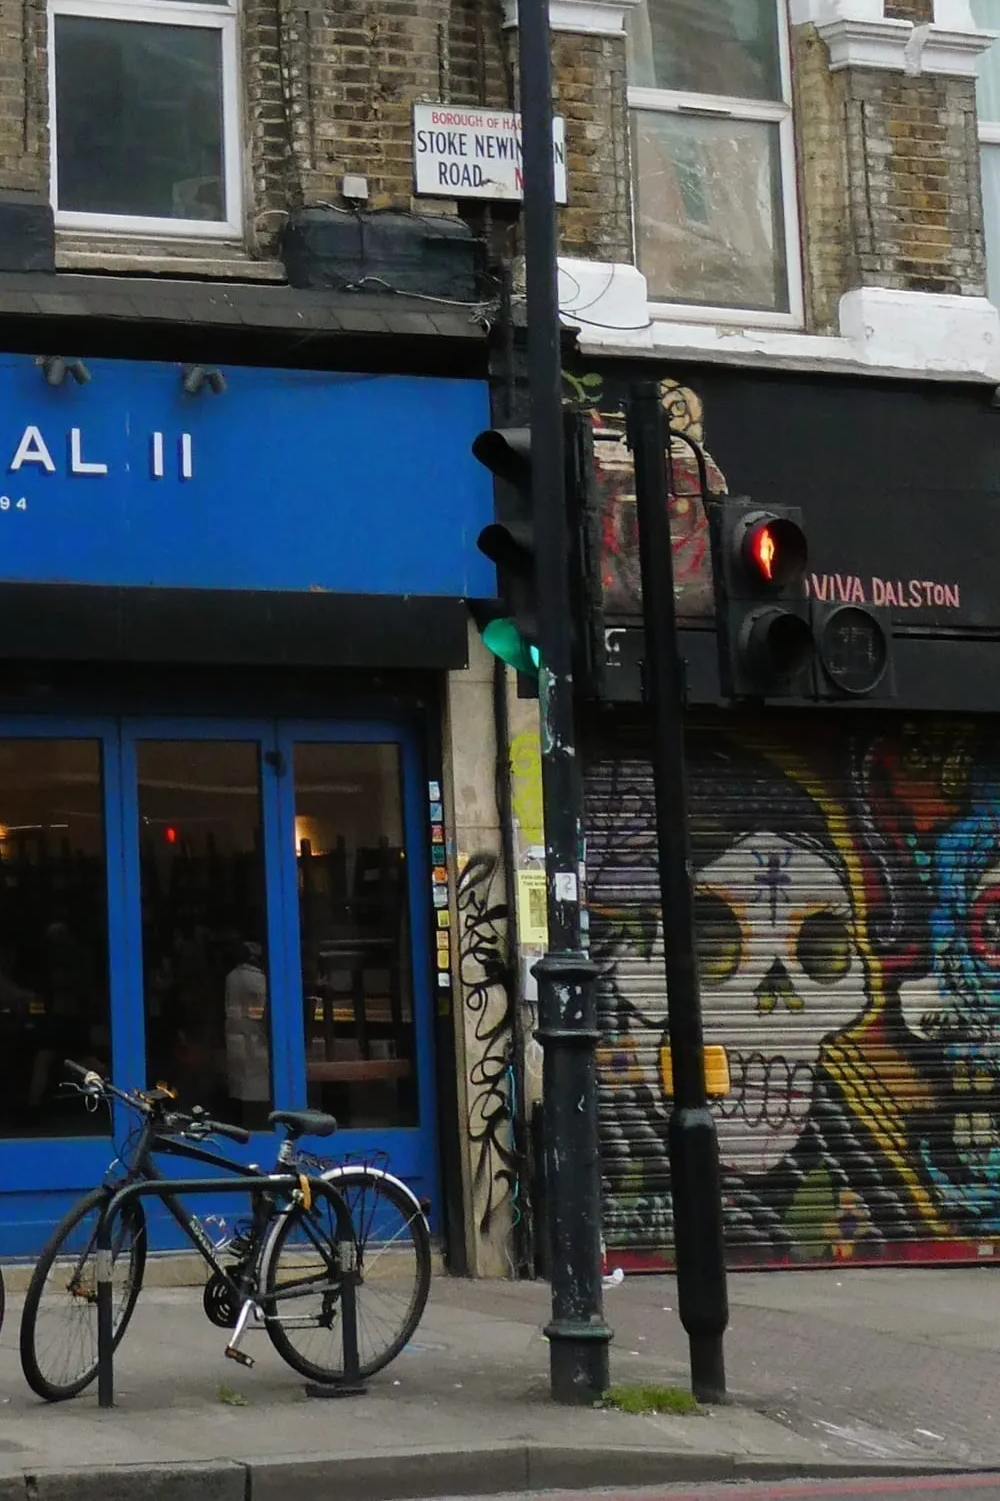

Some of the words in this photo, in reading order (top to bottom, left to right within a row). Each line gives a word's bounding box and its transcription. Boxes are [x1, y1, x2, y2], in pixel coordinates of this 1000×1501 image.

[432, 111, 483, 128] BOROUGH
[487, 117, 500, 128] OF
[417, 130, 468, 156] STOKE
[439, 161, 482, 188] ROAD
[152, 431, 193, 478] II
[872, 576, 961, 608] DALSTON
